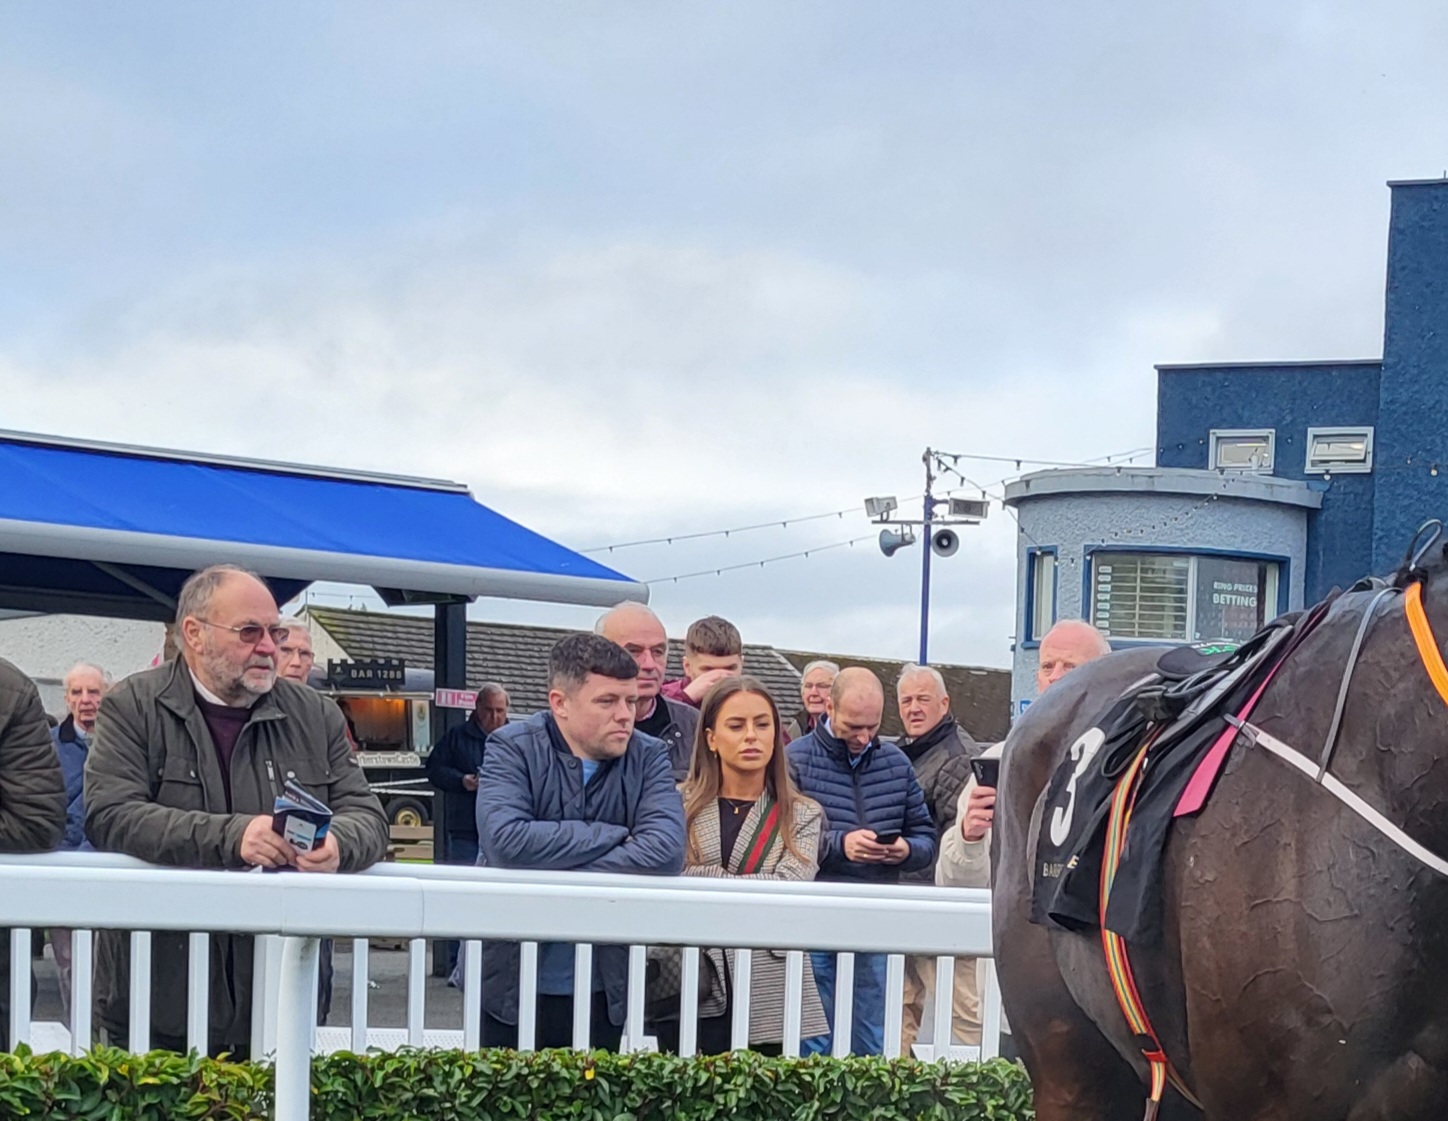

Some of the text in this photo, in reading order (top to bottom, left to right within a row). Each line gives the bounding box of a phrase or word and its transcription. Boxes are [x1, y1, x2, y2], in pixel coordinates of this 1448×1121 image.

[1212, 593, 1258, 607] BETTING
[350, 669, 373, 679] BAR
[1050, 727, 1105, 847] 3
